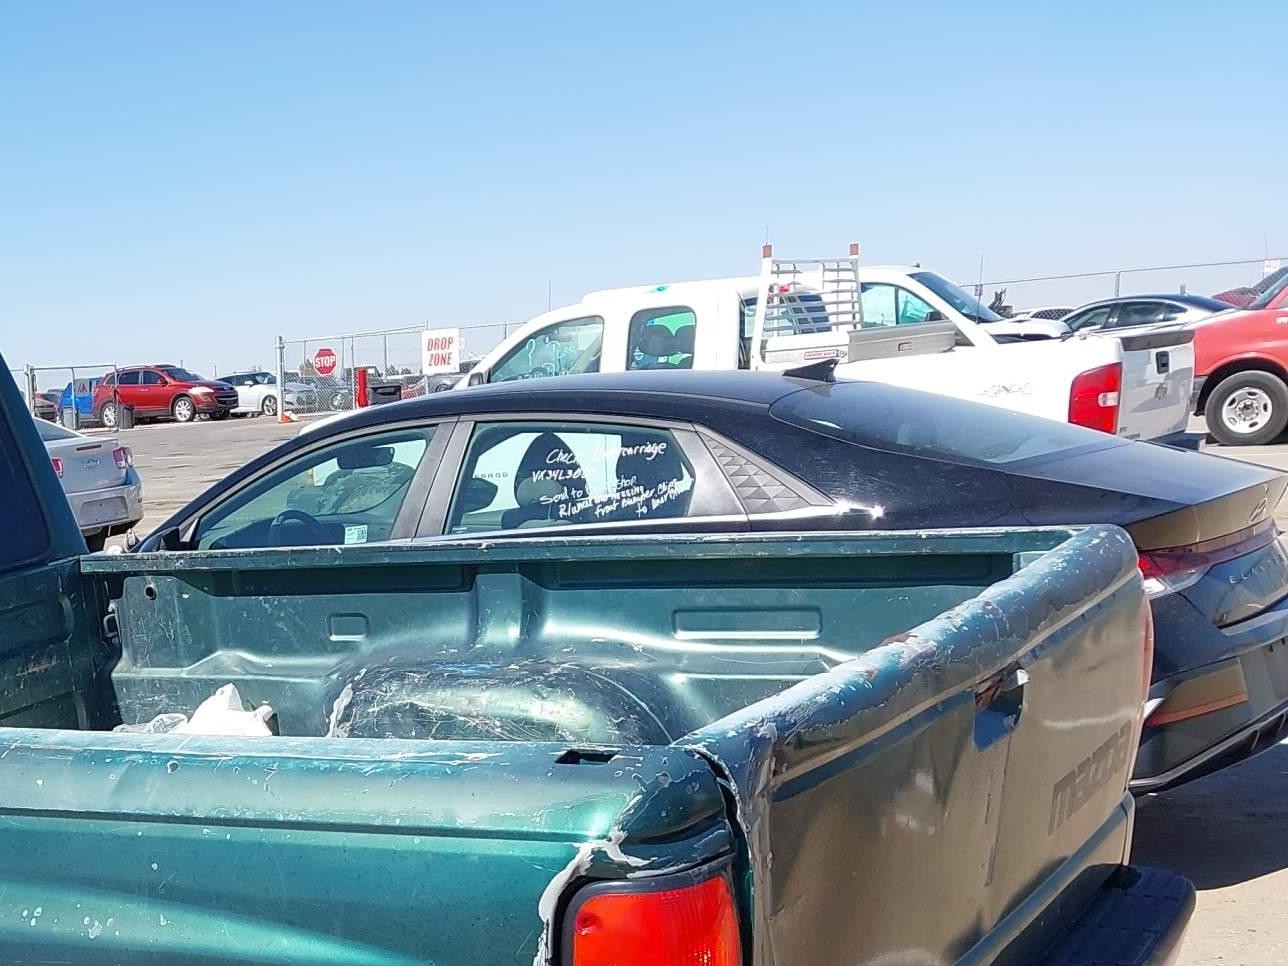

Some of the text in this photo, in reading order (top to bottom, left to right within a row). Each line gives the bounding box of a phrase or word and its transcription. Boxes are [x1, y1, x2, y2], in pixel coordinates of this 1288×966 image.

[426, 335, 454, 351] DROP
[314, 356, 336, 369] STOP
[428, 351, 453, 367] ZONE
